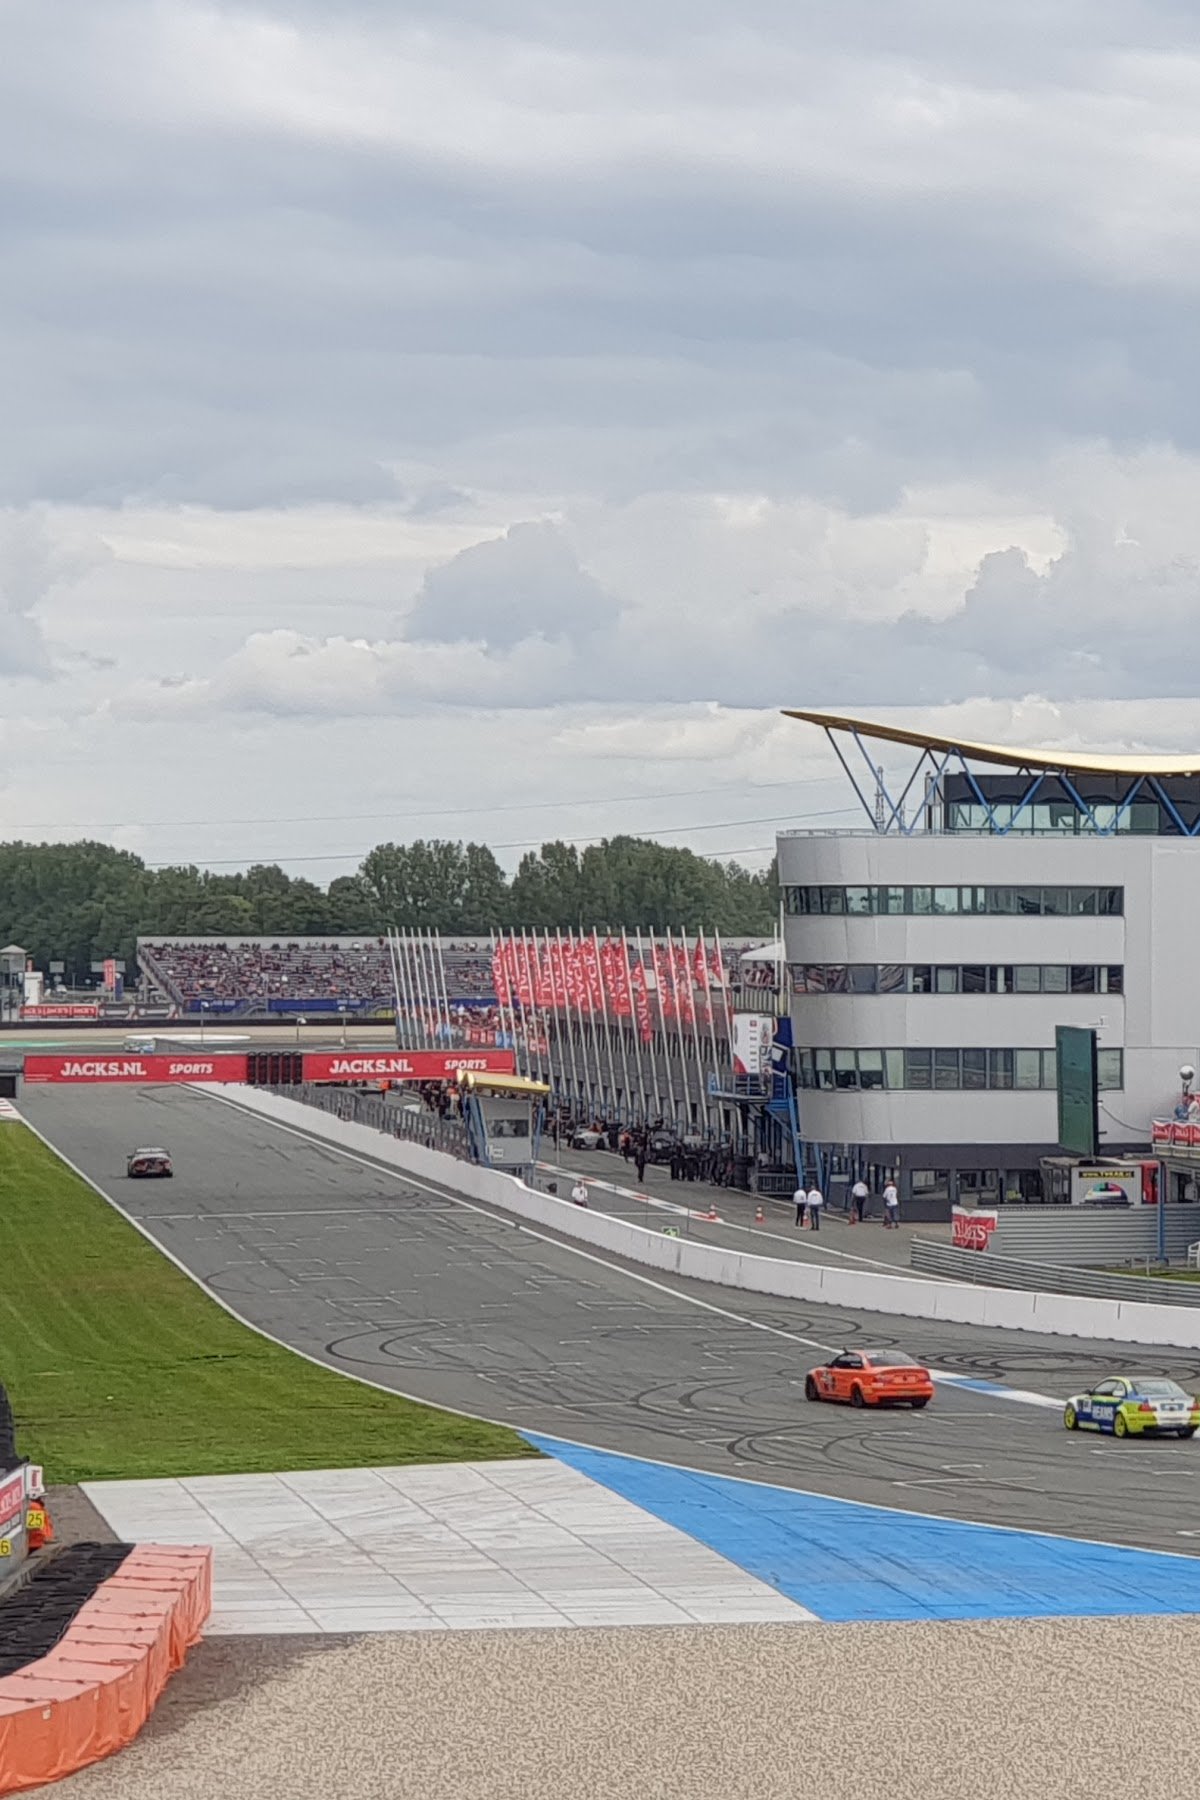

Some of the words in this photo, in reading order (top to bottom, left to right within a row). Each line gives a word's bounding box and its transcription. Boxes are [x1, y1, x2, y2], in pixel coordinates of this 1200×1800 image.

[61, 1062, 147, 1076] JACKS.NL
[168, 1062, 214, 1075] SPORTS
[328, 1059, 414, 1074] JACKS.NL
[444, 1059, 488, 1071] SPORTS
[28, 1513, 42, 1526] 25
